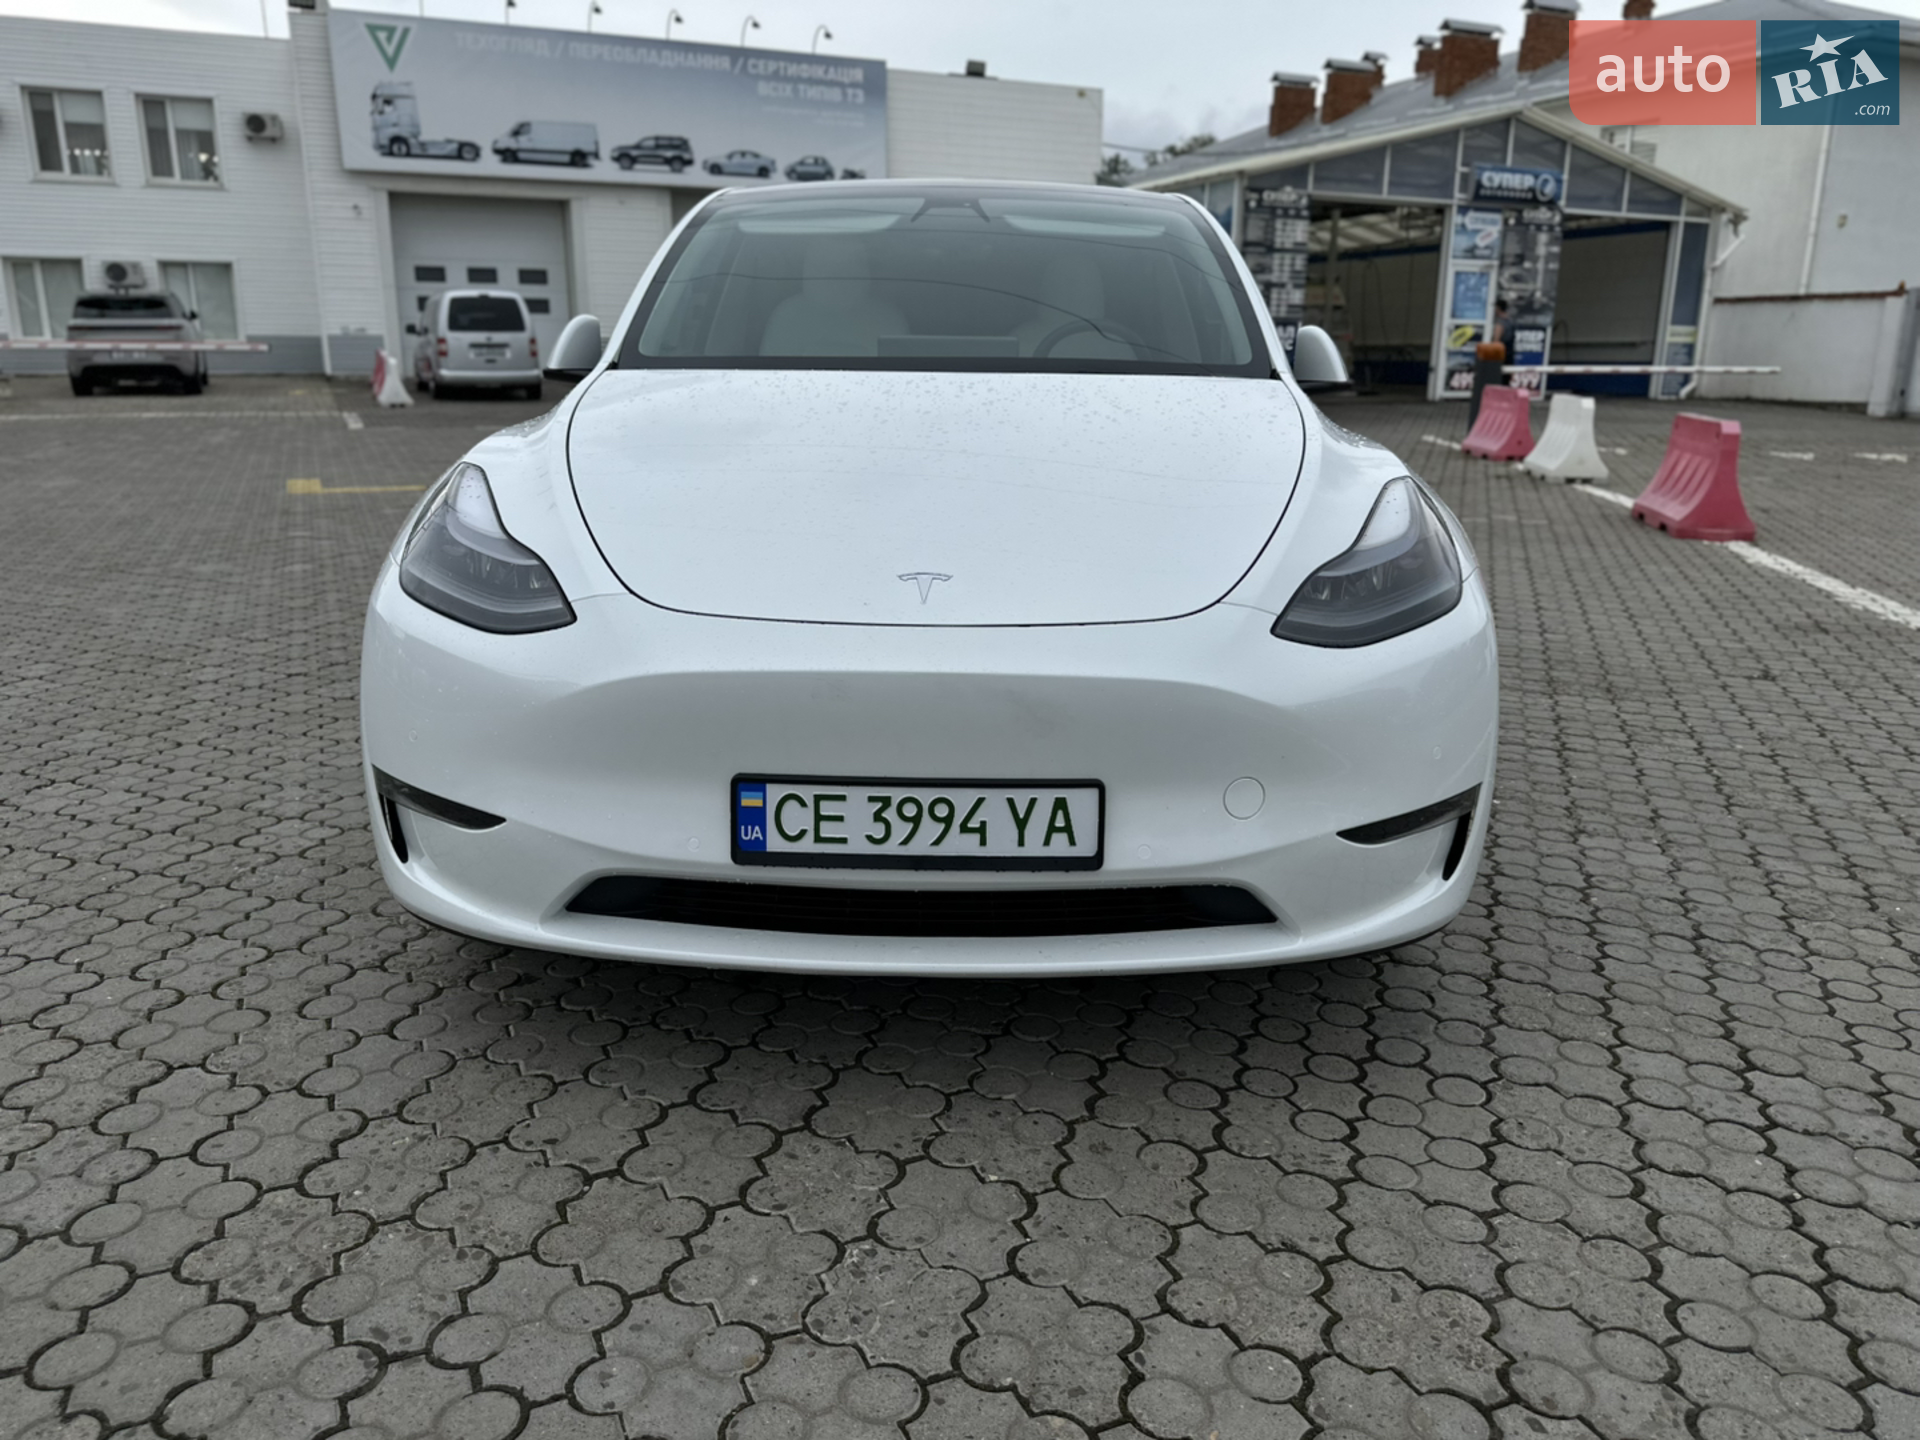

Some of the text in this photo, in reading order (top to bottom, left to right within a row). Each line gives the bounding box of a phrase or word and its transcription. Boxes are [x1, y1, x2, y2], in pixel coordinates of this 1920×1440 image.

[569, 42, 731, 73] ПЕРЕОБЛАДНАННЯ
[747, 57, 864, 84] СЕРТИФІКАЦІЯ
[1480, 171, 1536, 190] СУПЕР
[740, 826, 763, 841] UA
[774, 793, 1077, 847] CE 3994 YA
